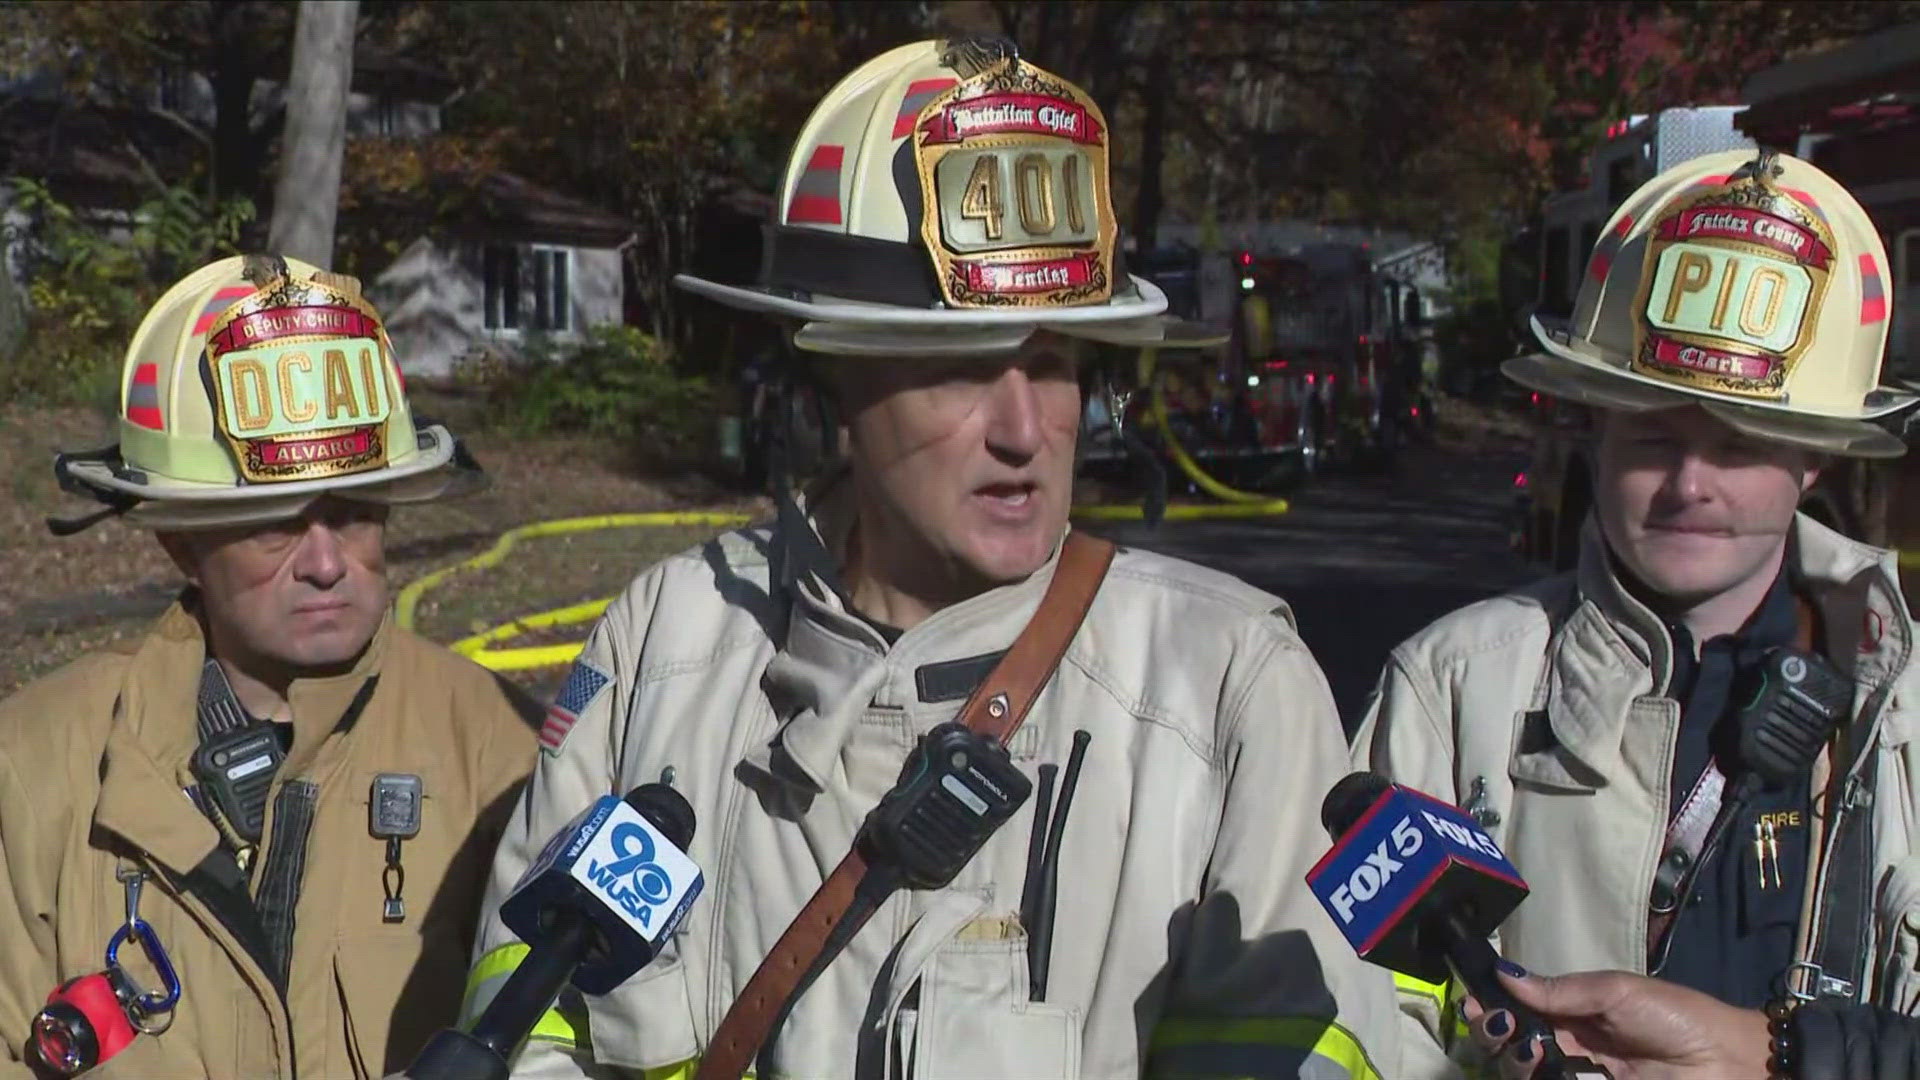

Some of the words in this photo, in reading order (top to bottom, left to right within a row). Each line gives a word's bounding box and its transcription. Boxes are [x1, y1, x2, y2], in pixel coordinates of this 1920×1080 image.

[1038, 106, 1076, 131] Chief
[961, 153, 1085, 240] 401
[1690, 213, 1749, 234] Fairfax
[1754, 218, 1805, 251] County
[1662, 250, 1788, 339] PIO
[243, 315, 300, 338] DEPUTY
[1678, 347, 1744, 374] Clark
[276, 439, 356, 460] ALVARO
[1420, 809, 1487, 855] FOX
[1474, 831, 1503, 860] 5
[1760, 811, 1800, 827] FIRE
[610, 821, 656, 878] 9
[1329, 839, 1404, 925] FOX
[1391, 814, 1424, 858] 5
[587, 858, 655, 930] WUSA
